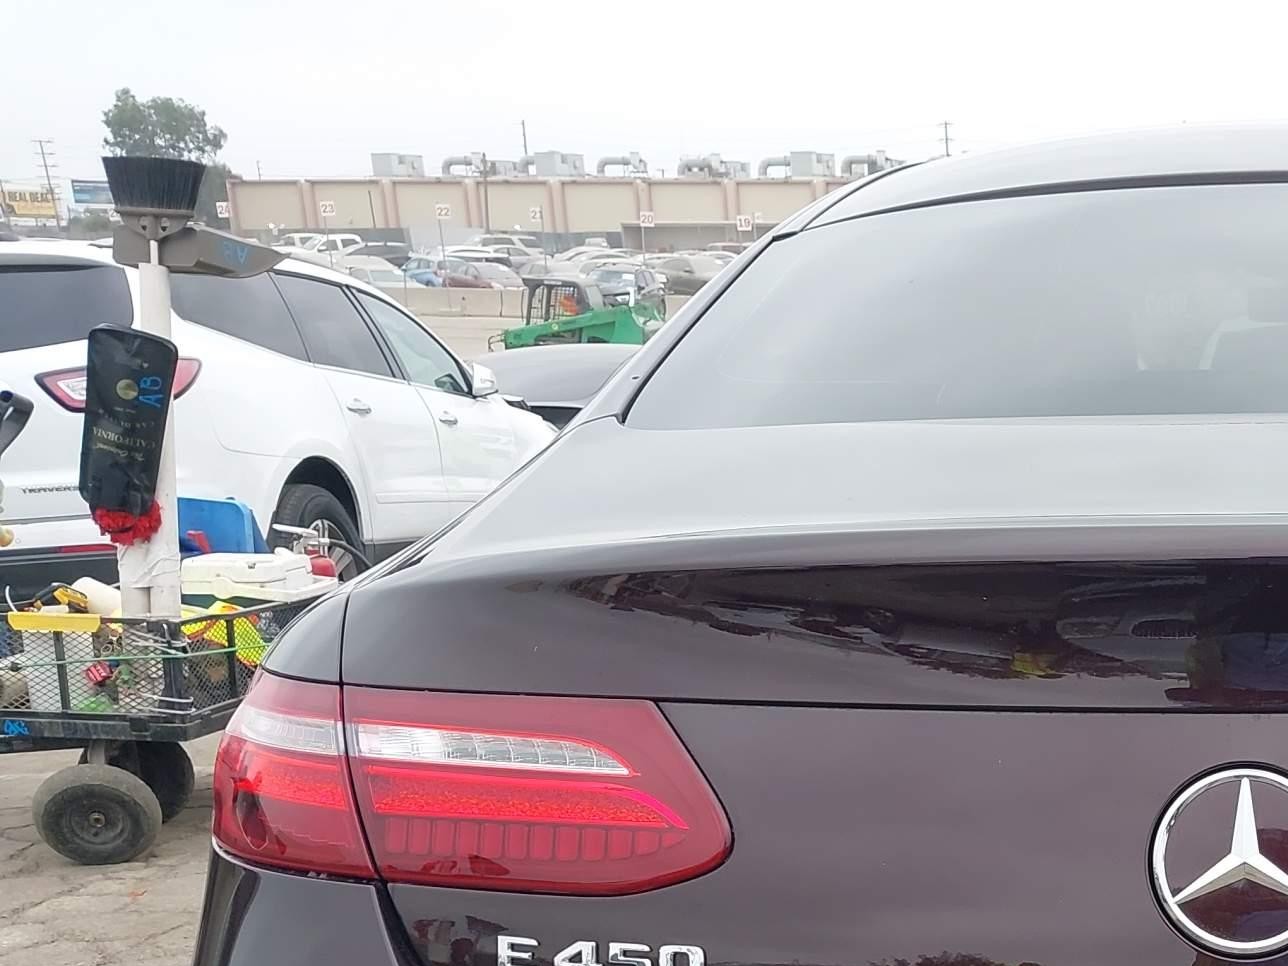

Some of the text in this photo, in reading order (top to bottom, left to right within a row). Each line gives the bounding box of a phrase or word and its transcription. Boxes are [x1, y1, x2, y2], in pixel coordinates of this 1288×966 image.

[321, 203, 335, 214] 23
[437, 208, 450, 217] 22
[531, 209, 543, 219] 21
[641, 214, 654, 224] 20
[738, 218, 751, 229] 19
[92, 426, 156, 449] CALIFORNIA
[21, 486, 80, 494] TRAVERS
